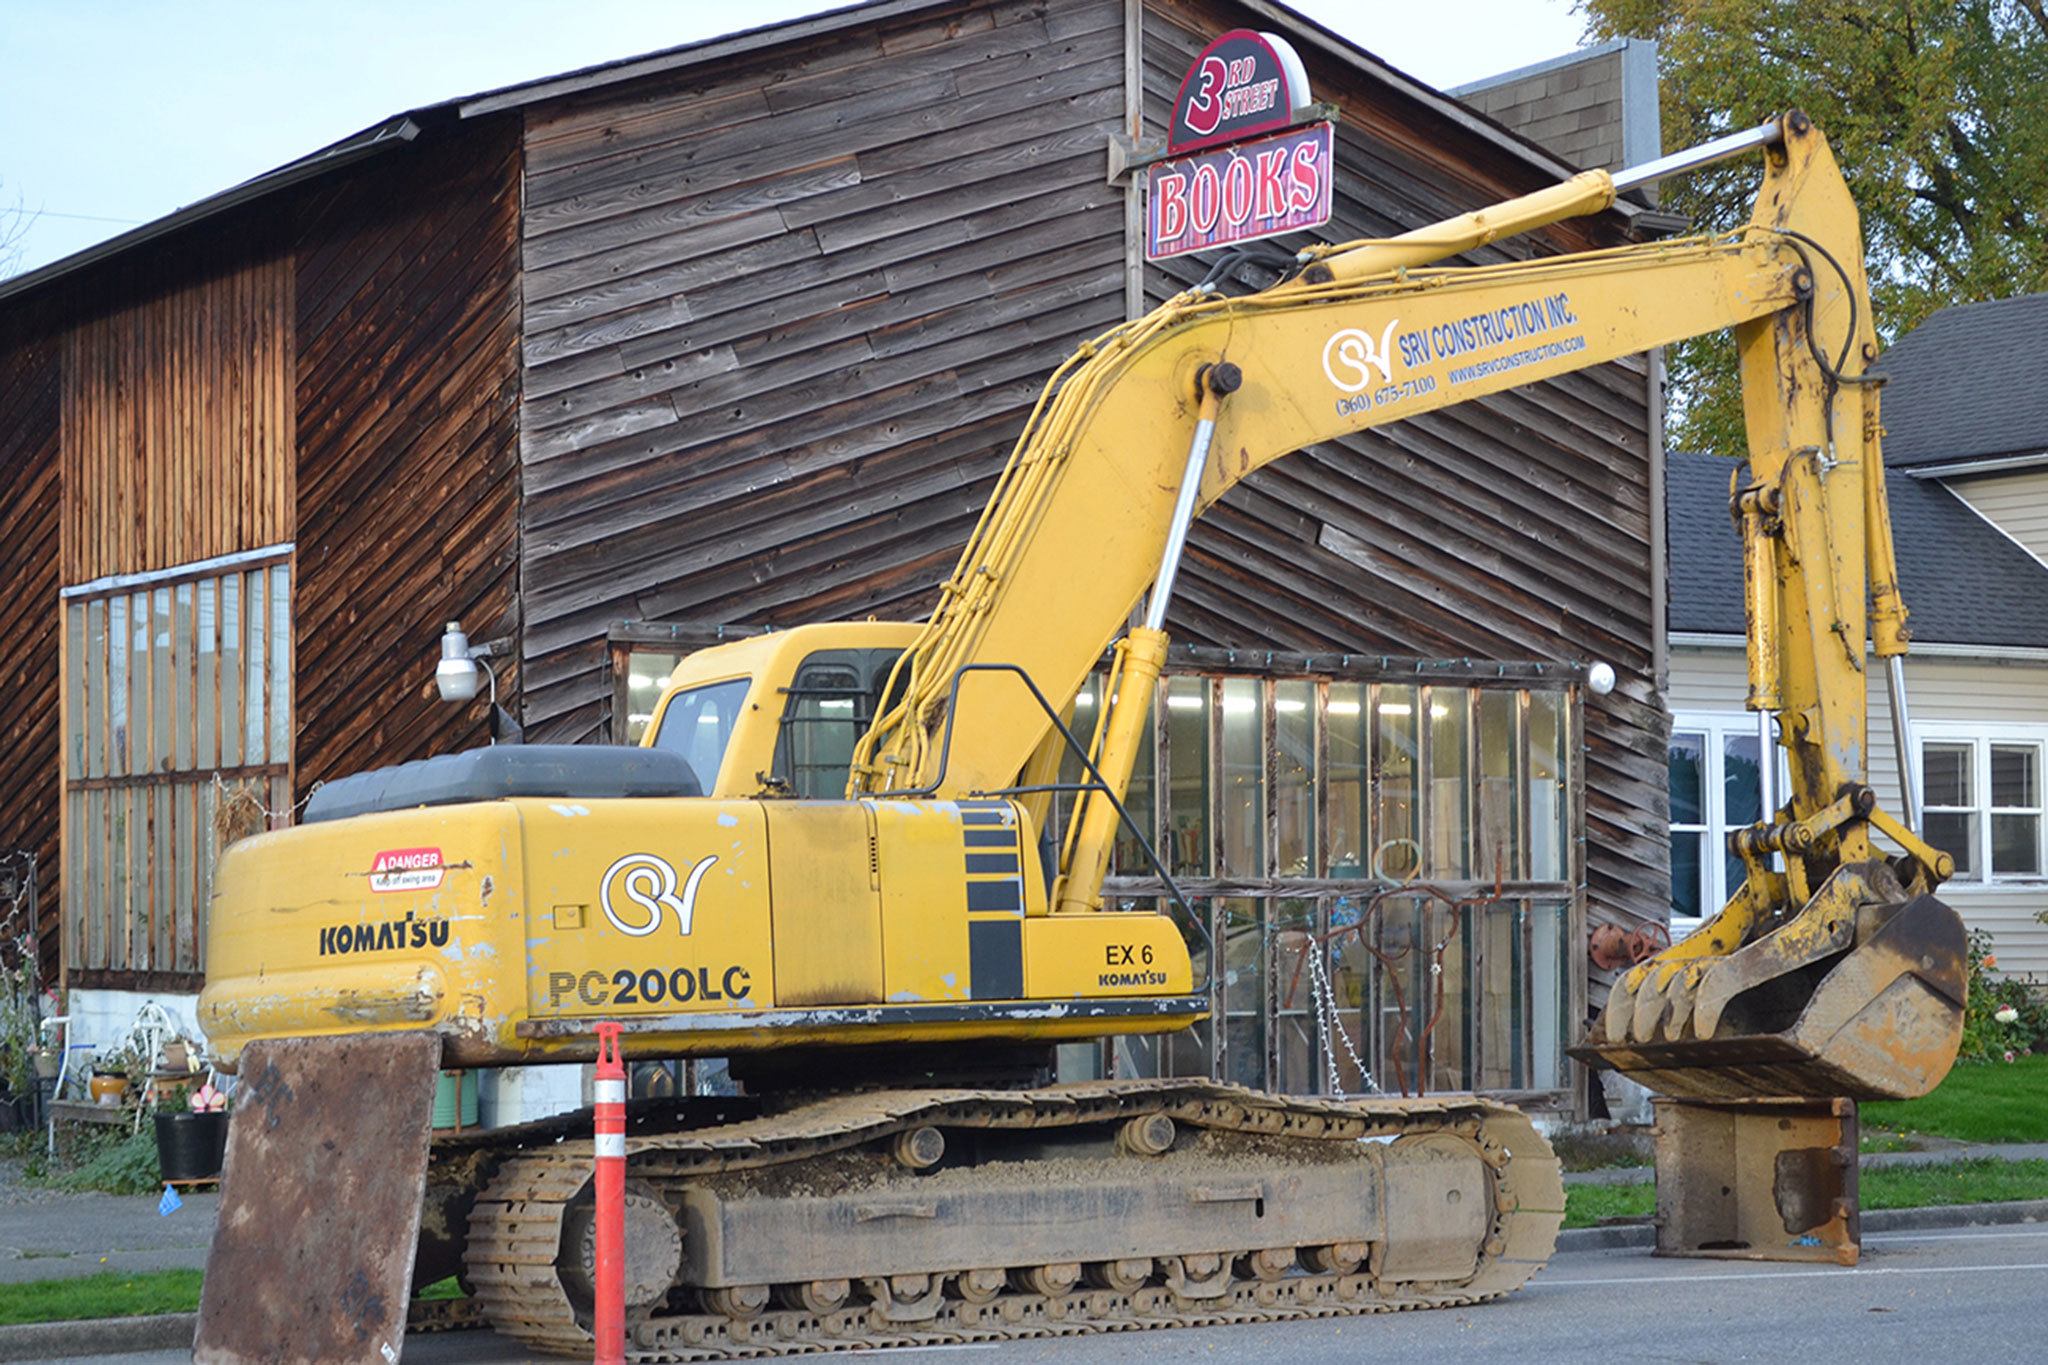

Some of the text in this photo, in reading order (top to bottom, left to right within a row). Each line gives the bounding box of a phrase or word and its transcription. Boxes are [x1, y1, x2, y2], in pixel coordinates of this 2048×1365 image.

[1184, 56, 1256, 135] 3 RD
[1222, 78, 1279, 120] STREET
[1156, 140, 1319, 243] BOOKS
[1398, 292, 1578, 368] SRV CONSTRUCTION INC.
[1335, 375, 1436, 417] (360) 675-7100
[387, 853, 439, 869] DANGER
[319, 911, 450, 955] KOMATSU
[1106, 945, 1153, 965] EX 6
[549, 965, 752, 1007] PC200LC
[1098, 969, 1167, 986] KOMATSU
